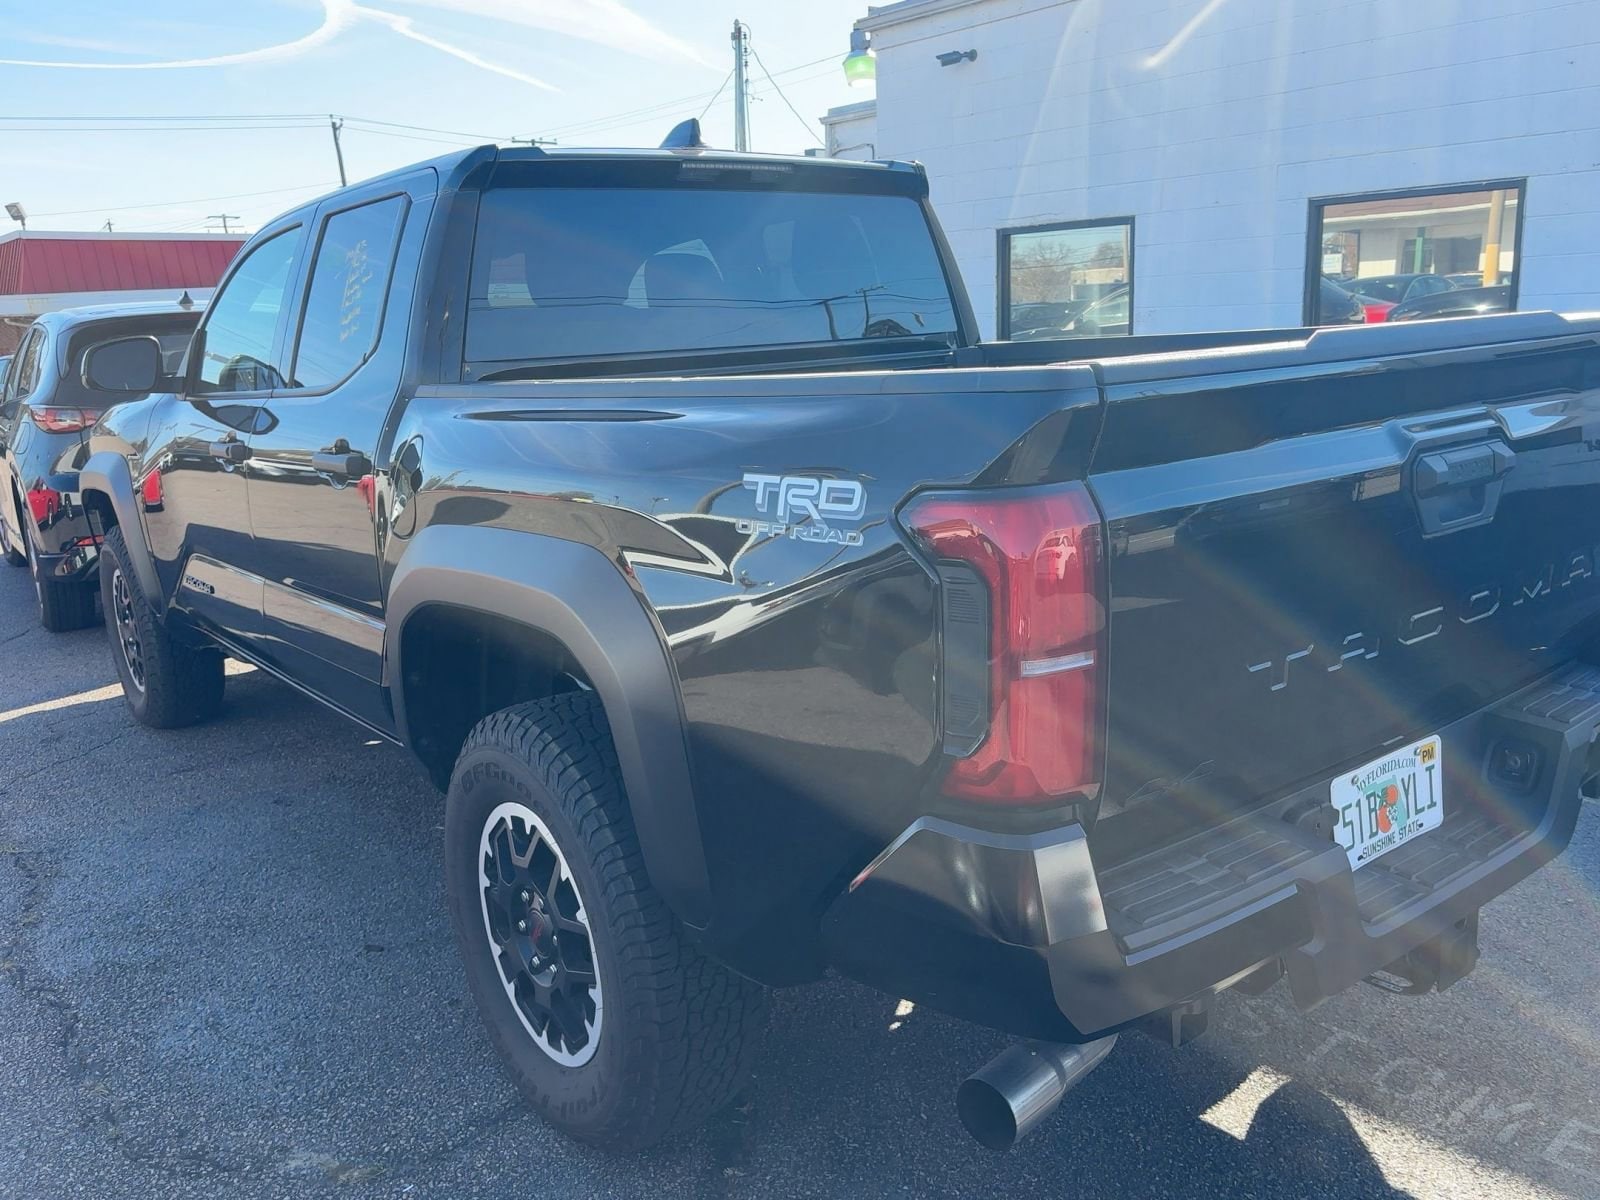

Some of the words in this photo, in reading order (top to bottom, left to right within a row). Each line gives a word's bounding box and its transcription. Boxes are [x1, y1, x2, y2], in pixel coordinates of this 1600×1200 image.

[743, 473, 867, 525] TRD
[735, 519, 787, 537] OFF
[789, 525, 864, 546] ROAD
[1246, 555, 1592, 692] TACOMA
[1355, 757, 1417, 792] MYFLORIDA.COM
[1421, 747, 1435, 763] PM
[1401, 764, 1437, 820] YLI
[1362, 831, 1397, 860] SUNSHINE
[1399, 819, 1420, 840] STATE
